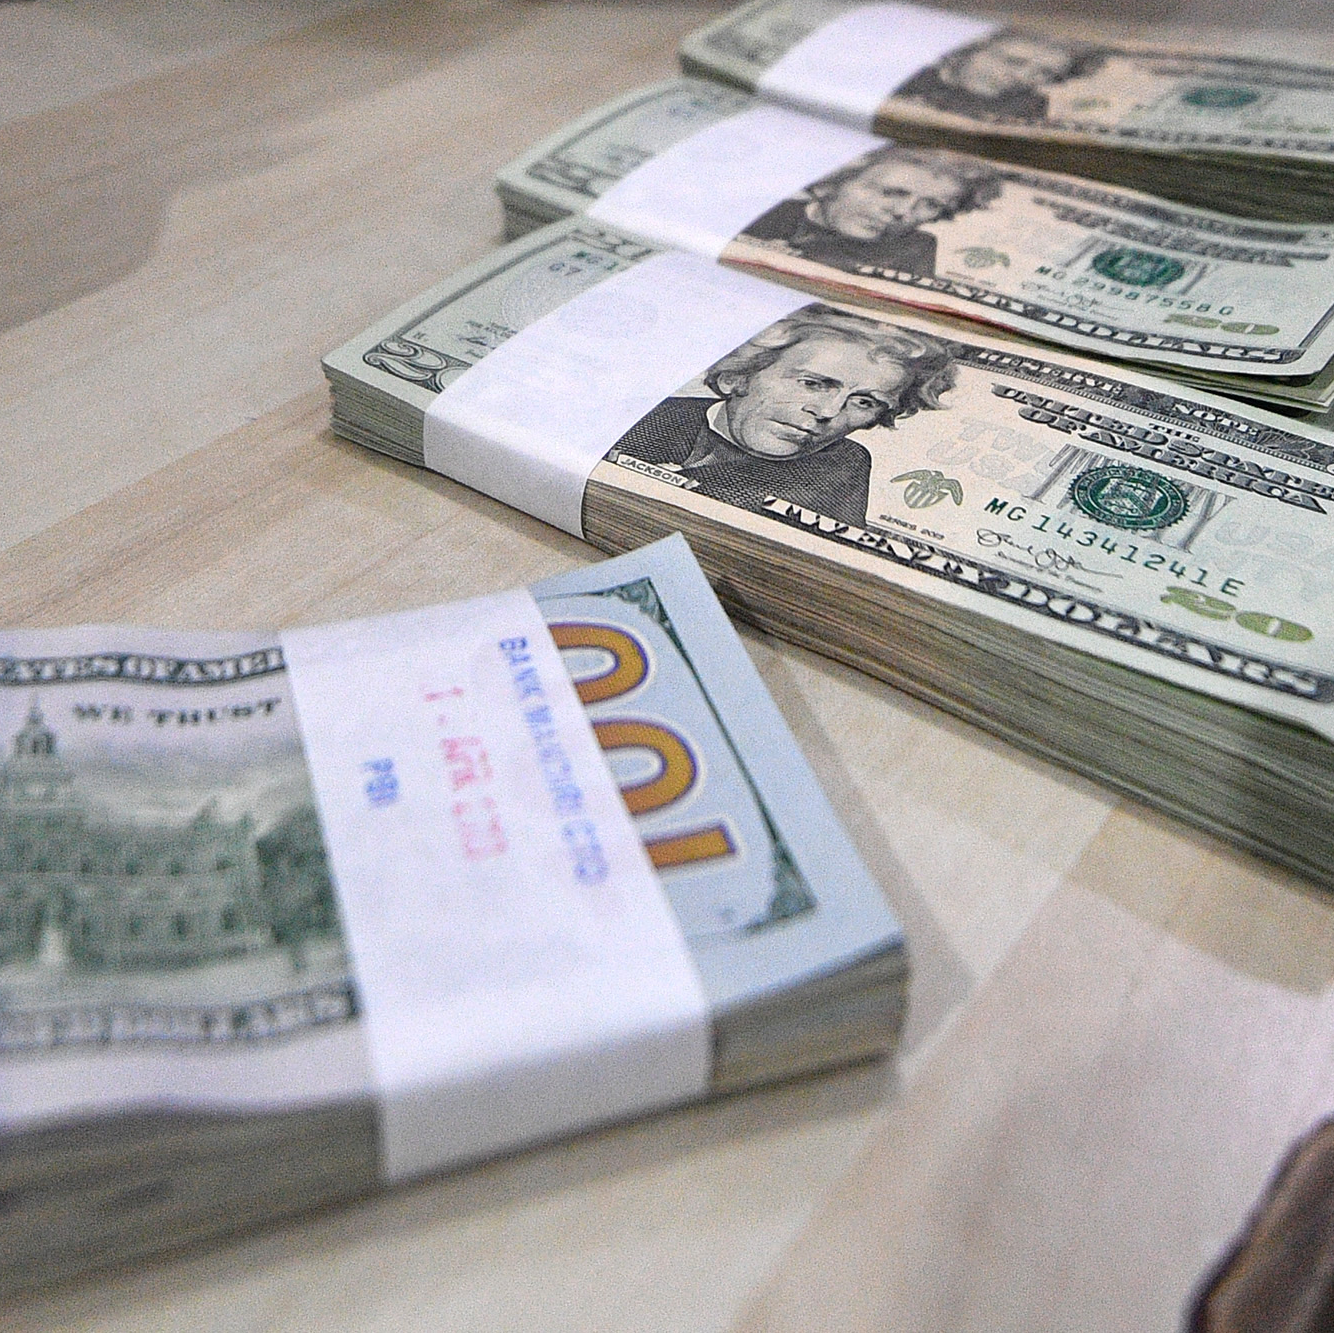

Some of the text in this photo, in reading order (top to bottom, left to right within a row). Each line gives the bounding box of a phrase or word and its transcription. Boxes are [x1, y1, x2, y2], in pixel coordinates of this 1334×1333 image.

[991, 382, 1168, 446] UNITED
[1170, 401, 1260, 438] NOTE
[620, 458, 683, 485] JACKSON
[1078, 430, 1327, 515] AMERICA
[998, 576, 1319, 697] DOLLARS
[1160, 586, 1315, 643] 20
[74, 702, 131, 724] WE
[147, 696, 283, 728] TRUST
